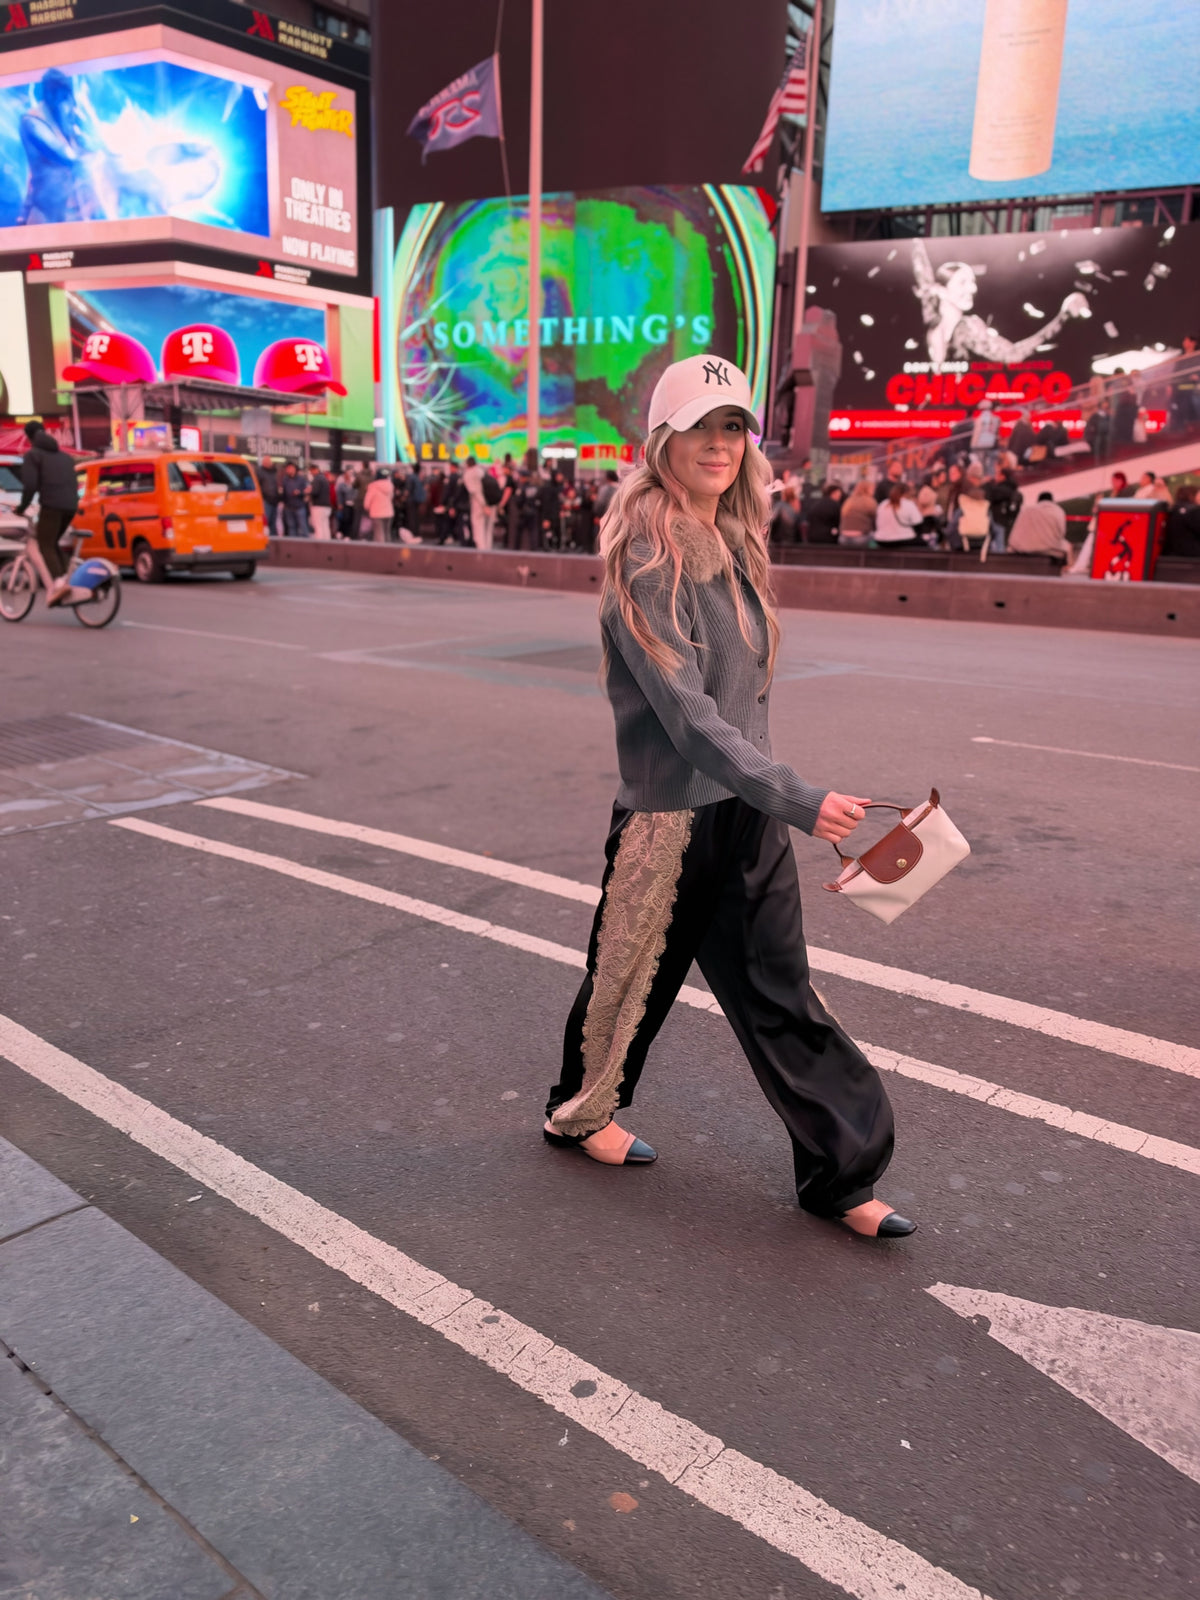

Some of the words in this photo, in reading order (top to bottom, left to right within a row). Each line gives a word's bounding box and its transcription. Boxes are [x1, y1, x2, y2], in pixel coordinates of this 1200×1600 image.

[291, 177, 326, 205] ONLY
[328, 186, 343, 210] IN
[284, 197, 351, 233] THEATRES
[282, 235, 309, 258] NOW
[310, 242, 355, 268] PLAYING
[433, 314, 711, 349] SOMETHING'S
[702, 361, 732, 386] NY
[886, 371, 1073, 407] CHICAGO
